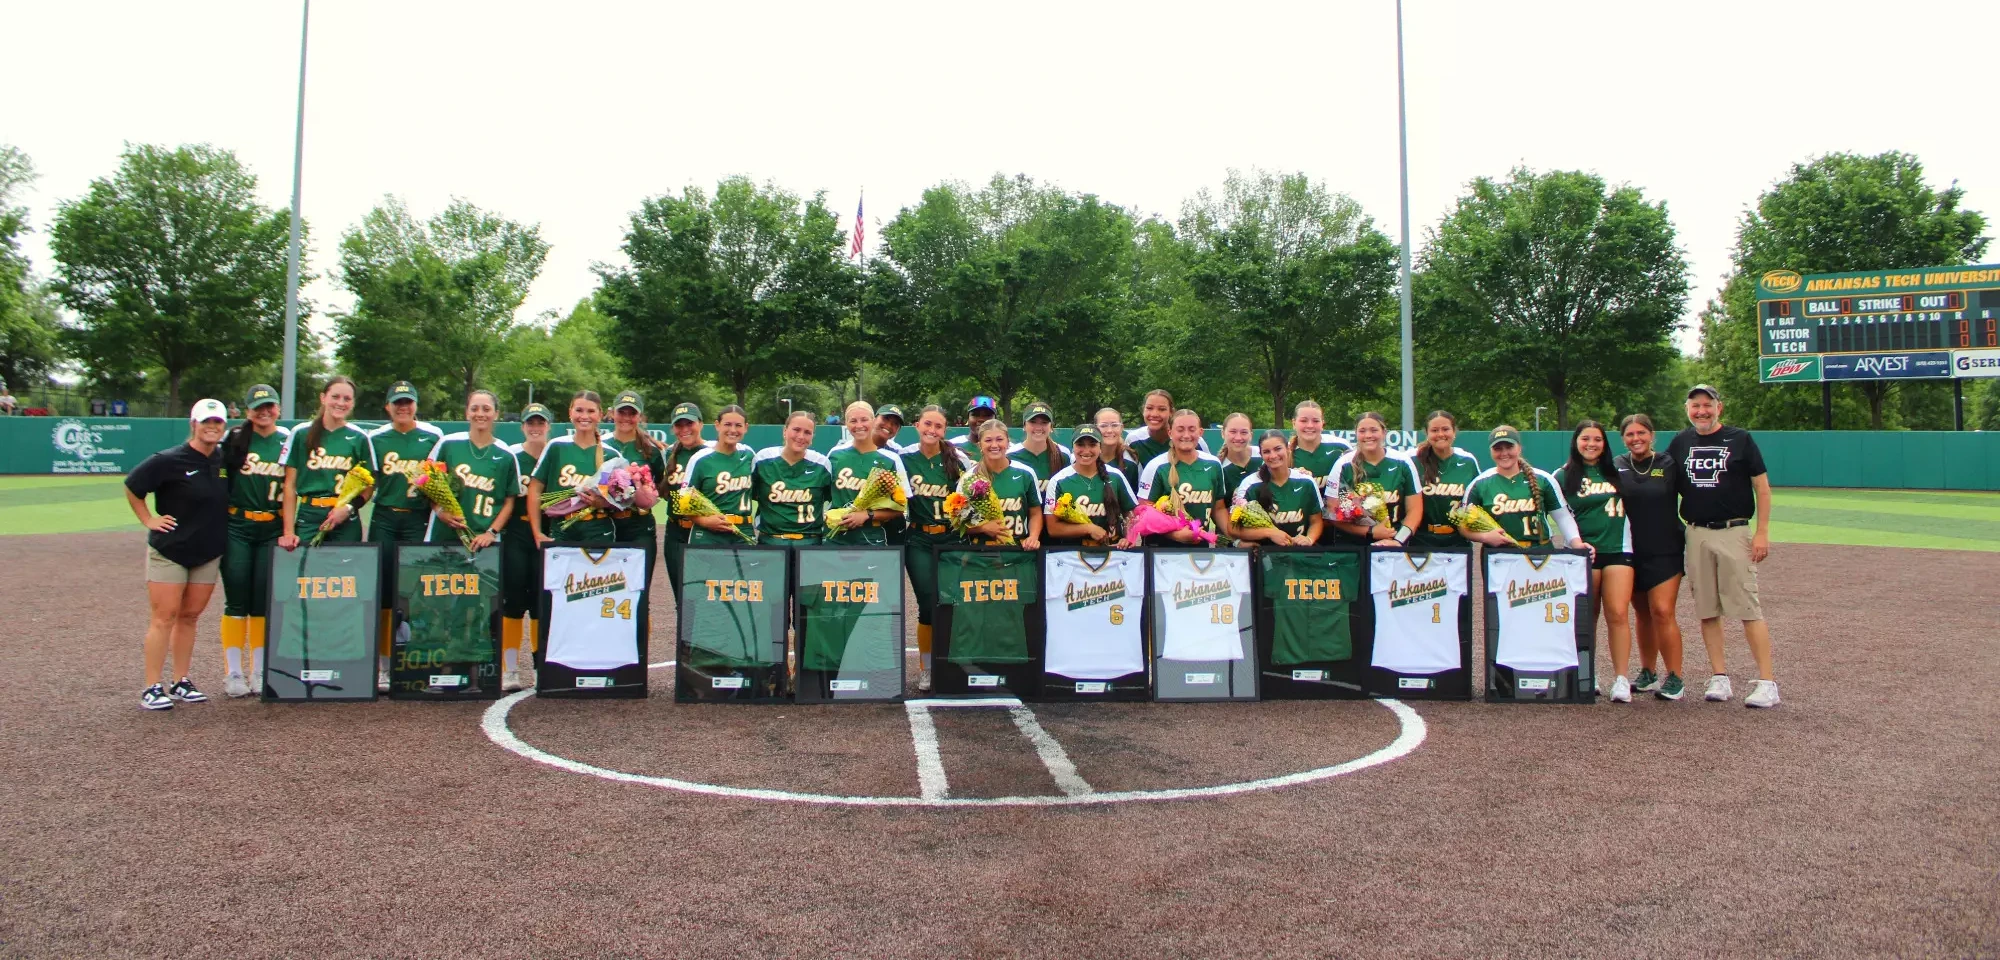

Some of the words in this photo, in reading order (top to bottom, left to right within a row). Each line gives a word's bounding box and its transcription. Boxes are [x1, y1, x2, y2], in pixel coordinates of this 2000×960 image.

[1767, 276, 1796, 287] TECH
[1805, 276, 1881, 291] ARKANSAS
[1884, 274, 1921, 287] TECH
[1809, 301, 1839, 313] BALL
[1858, 298, 1900, 310] STRIKE
[1920, 296, 1946, 307] OUT
[1765, 318, 1775, 326] AT
[1779, 317, 1796, 326] BAT
[1819, 318, 1824, 326] 1
[1855, 316, 1862, 324] 4
[1880, 315, 1886, 323] 6
[1892, 314, 1899, 322] 7
[1918, 313, 1925, 321] 9
[1929, 312, 1940, 320] 10
[1982, 310, 1990, 318] H
[1769, 328, 1810, 340] VISITOR
[1773, 342, 1807, 352] TECH
[1854, 356, 1909, 375] ARVEST
[1329, 430, 1417, 447] VEON
[307, 446, 352, 470] Suns
[1688, 458, 1724, 469] TECH
[455, 464, 495, 492] Suns
[715, 471, 752, 495] Suns
[835, 468, 867, 490] Sun
[910, 475, 950, 498] Suns
[768, 481, 813, 503] Suns
[473, 494, 495, 517] 16
[1491, 493, 1537, 516] Suns
[1604, 497, 1625, 517] 44
[297, 576, 356, 599] TECH
[421, 573, 480, 596] TECH
[564, 571, 626, 594] Arkansas
[582, 587, 610, 598] TECH
[705, 579, 763, 602] TECH
[822, 580, 879, 603] TECH
[960, 579, 1018, 602] TECH
[1065, 579, 1125, 602] Arkansas
[1172, 579, 1231, 602] Arkansas
[1285, 579, 1341, 600] TECH
[1388, 577, 1447, 600] Arkansas
[1507, 577, 1566, 602] Arkansas
[600, 597, 632, 620] 24
[1083, 595, 1110, 607] TECH
[1191, 595, 1217, 606] TECH
[1405, 592, 1432, 604] TECH
[1525, 592, 1551, 604] TECH
[1109, 604, 1124, 625] 6
[1211, 604, 1233, 624] 18
[1431, 602, 1441, 623] 1
[1544, 602, 1570, 623] 13
